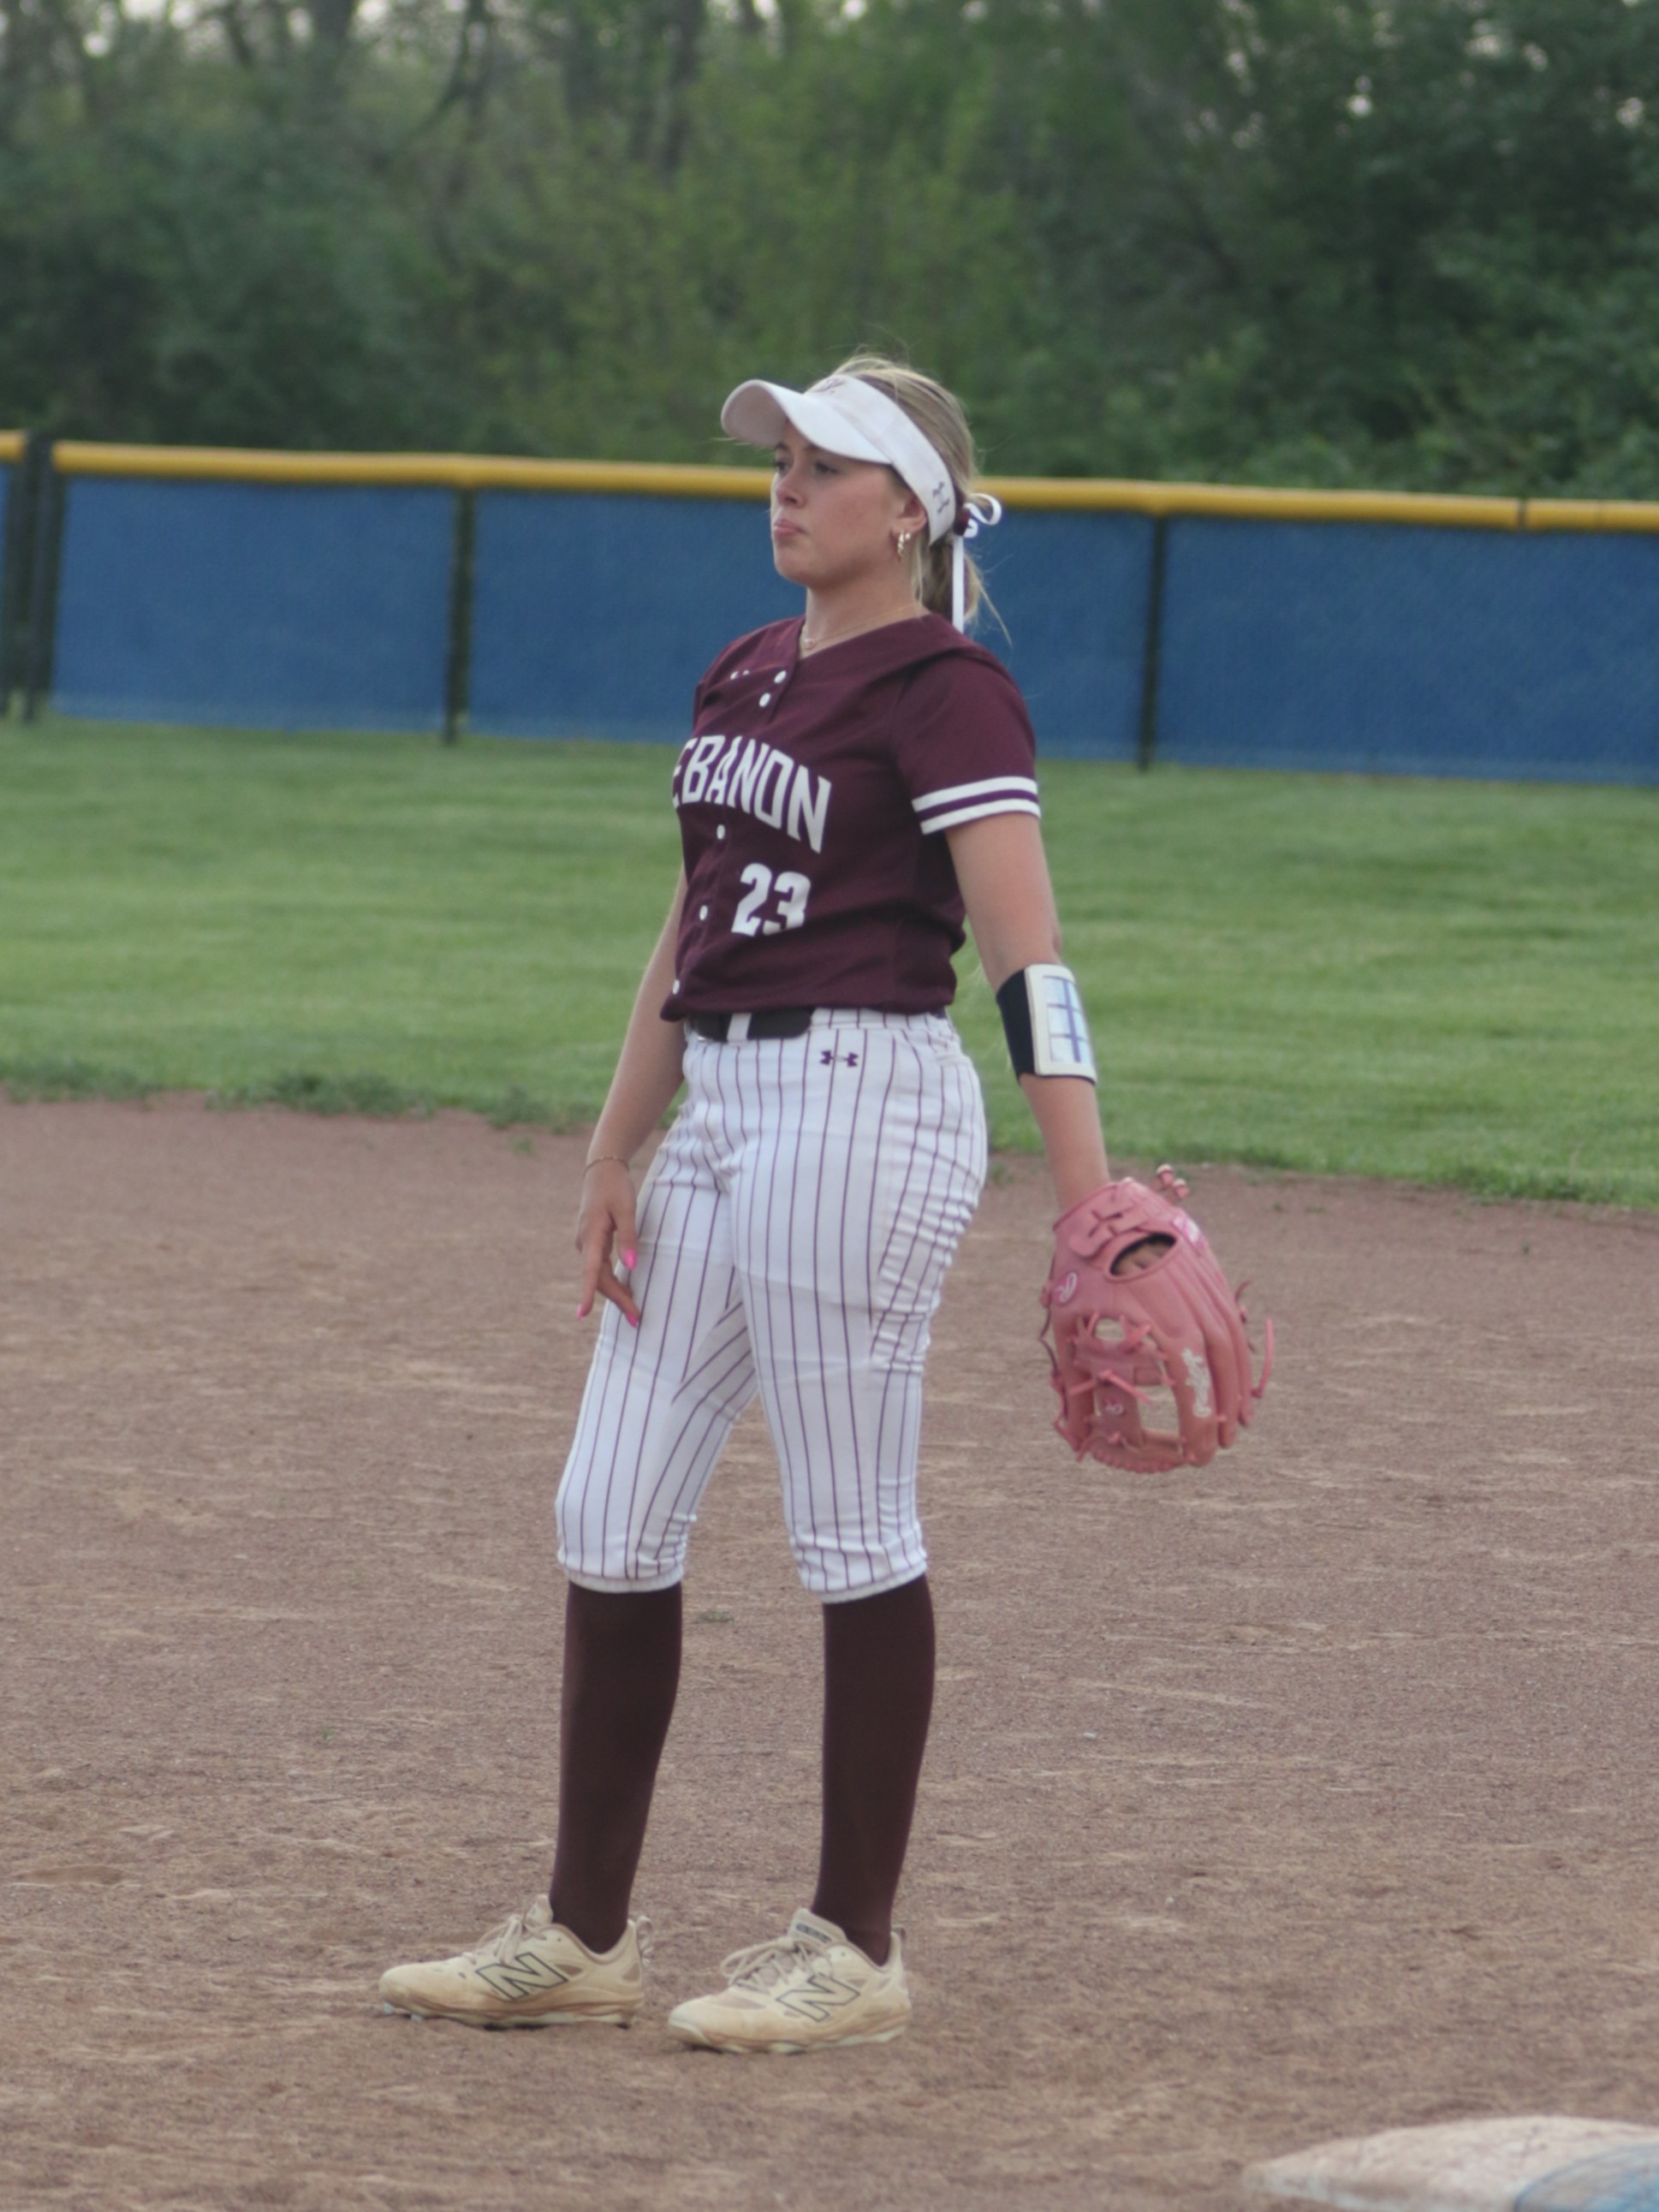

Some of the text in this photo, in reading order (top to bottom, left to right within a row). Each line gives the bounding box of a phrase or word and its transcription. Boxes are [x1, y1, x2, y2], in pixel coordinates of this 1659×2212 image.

[731, 863, 811, 937] 23
[474, 1952, 568, 2001] N
[776, 1972, 860, 2022] N
